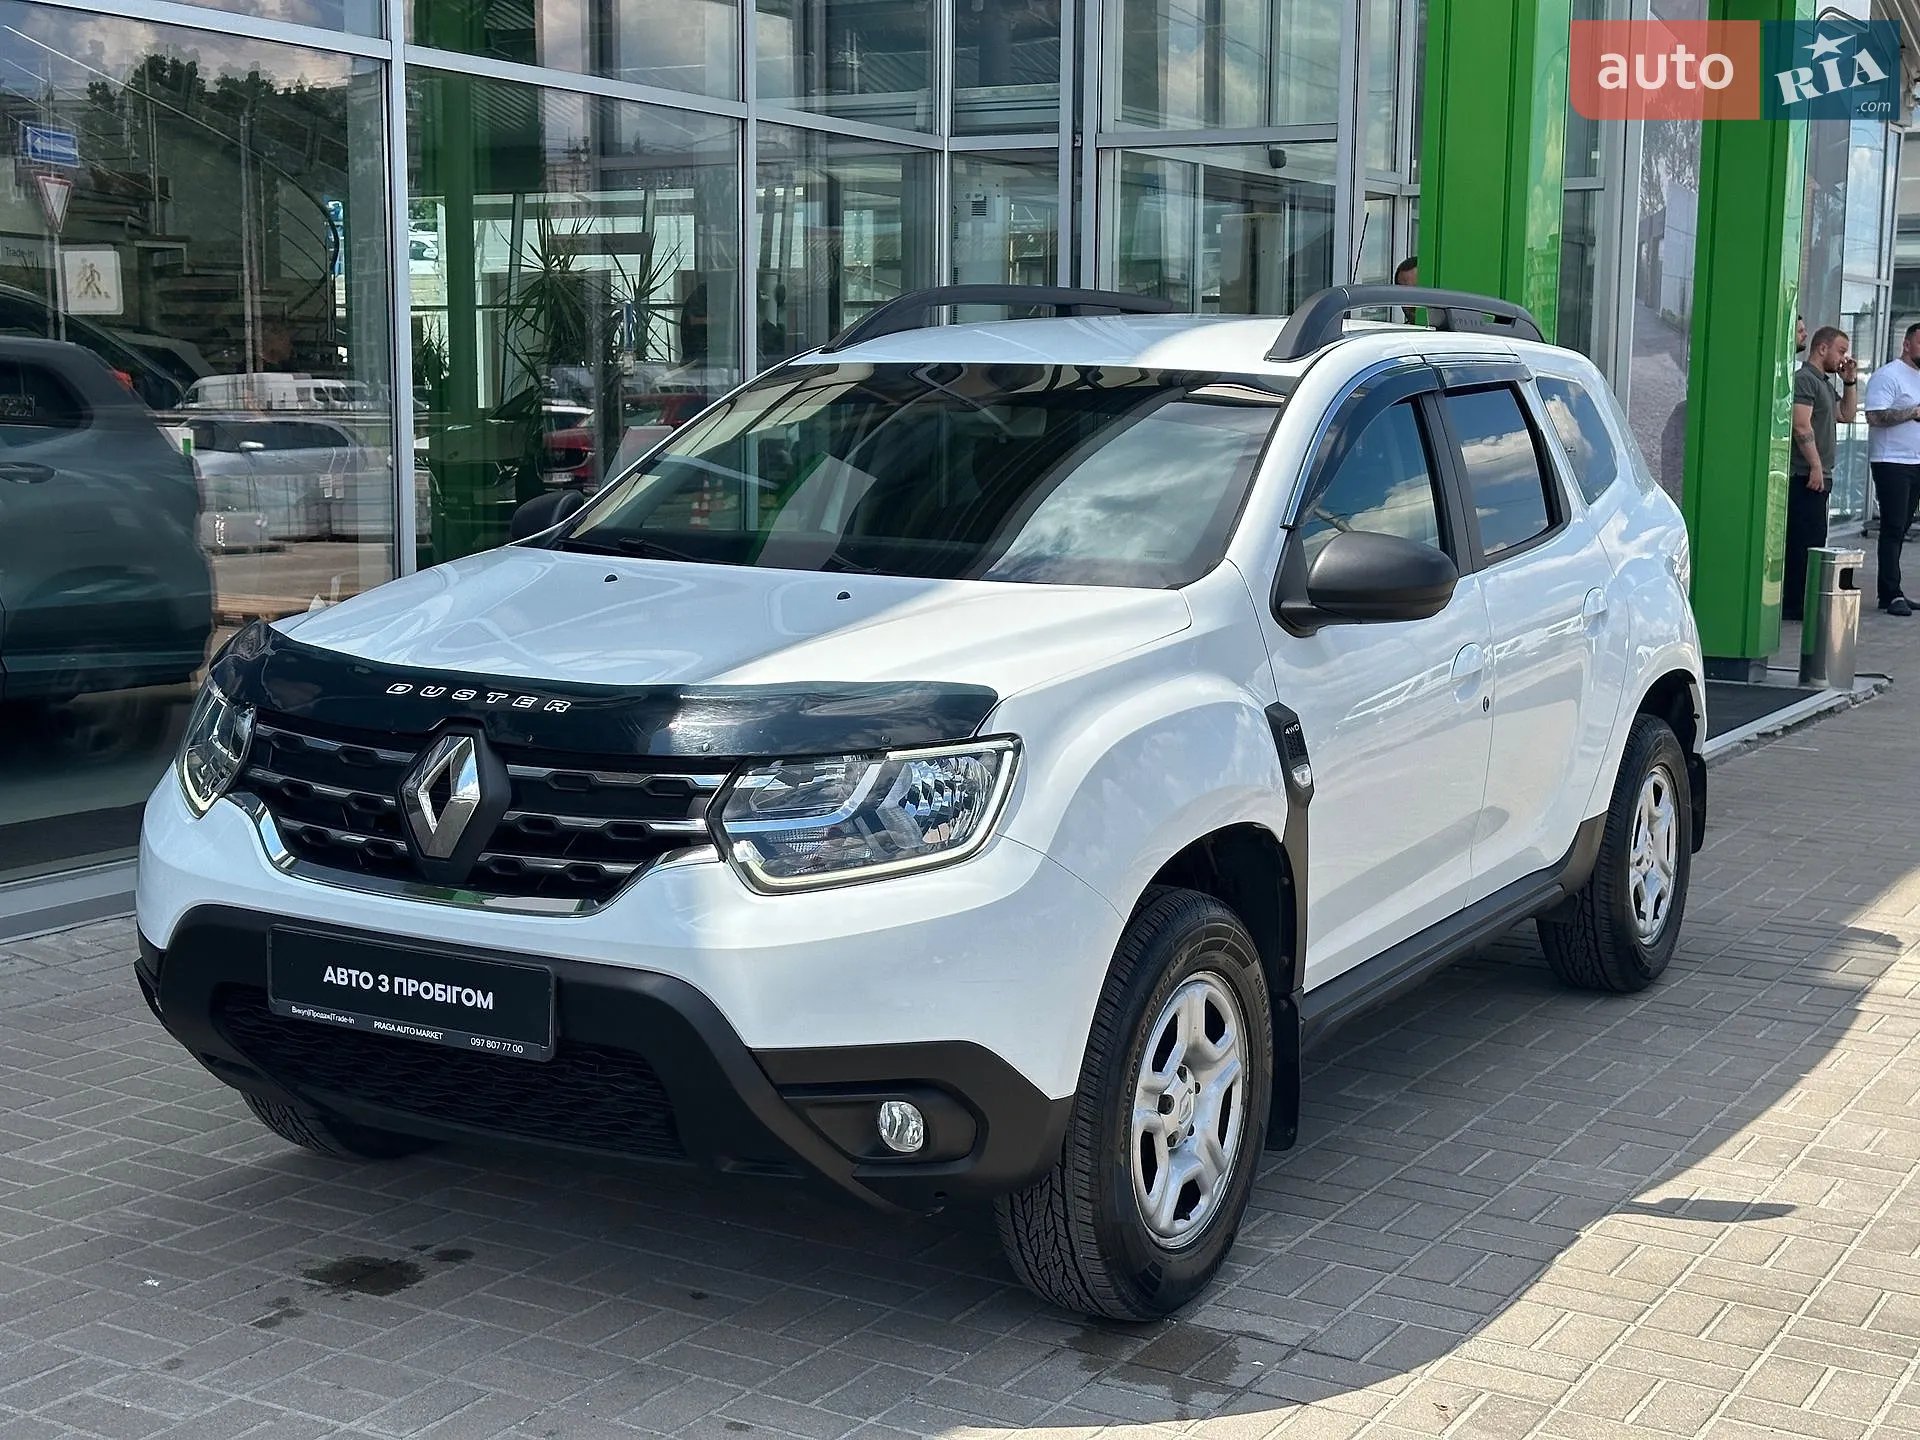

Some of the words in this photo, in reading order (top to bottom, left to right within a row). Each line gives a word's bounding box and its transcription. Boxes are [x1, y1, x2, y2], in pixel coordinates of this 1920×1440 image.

[386, 682, 572, 713] DUSTER
[1285, 724, 1300, 734] 4WD
[322, 965, 374, 990] АВТО
[394, 977, 494, 1010] ПРОБІГОМ
[373, 1020, 396, 1032] PRAGA
[396, 1025, 416, 1035] AUTO
[415, 1028, 444, 1040] MARKET
[470, 1037, 486, 1047] 097
[486, 1039, 501, 1050] 807
[501, 1042, 512, 1052] 77
[511, 1044, 524, 1055] 00
